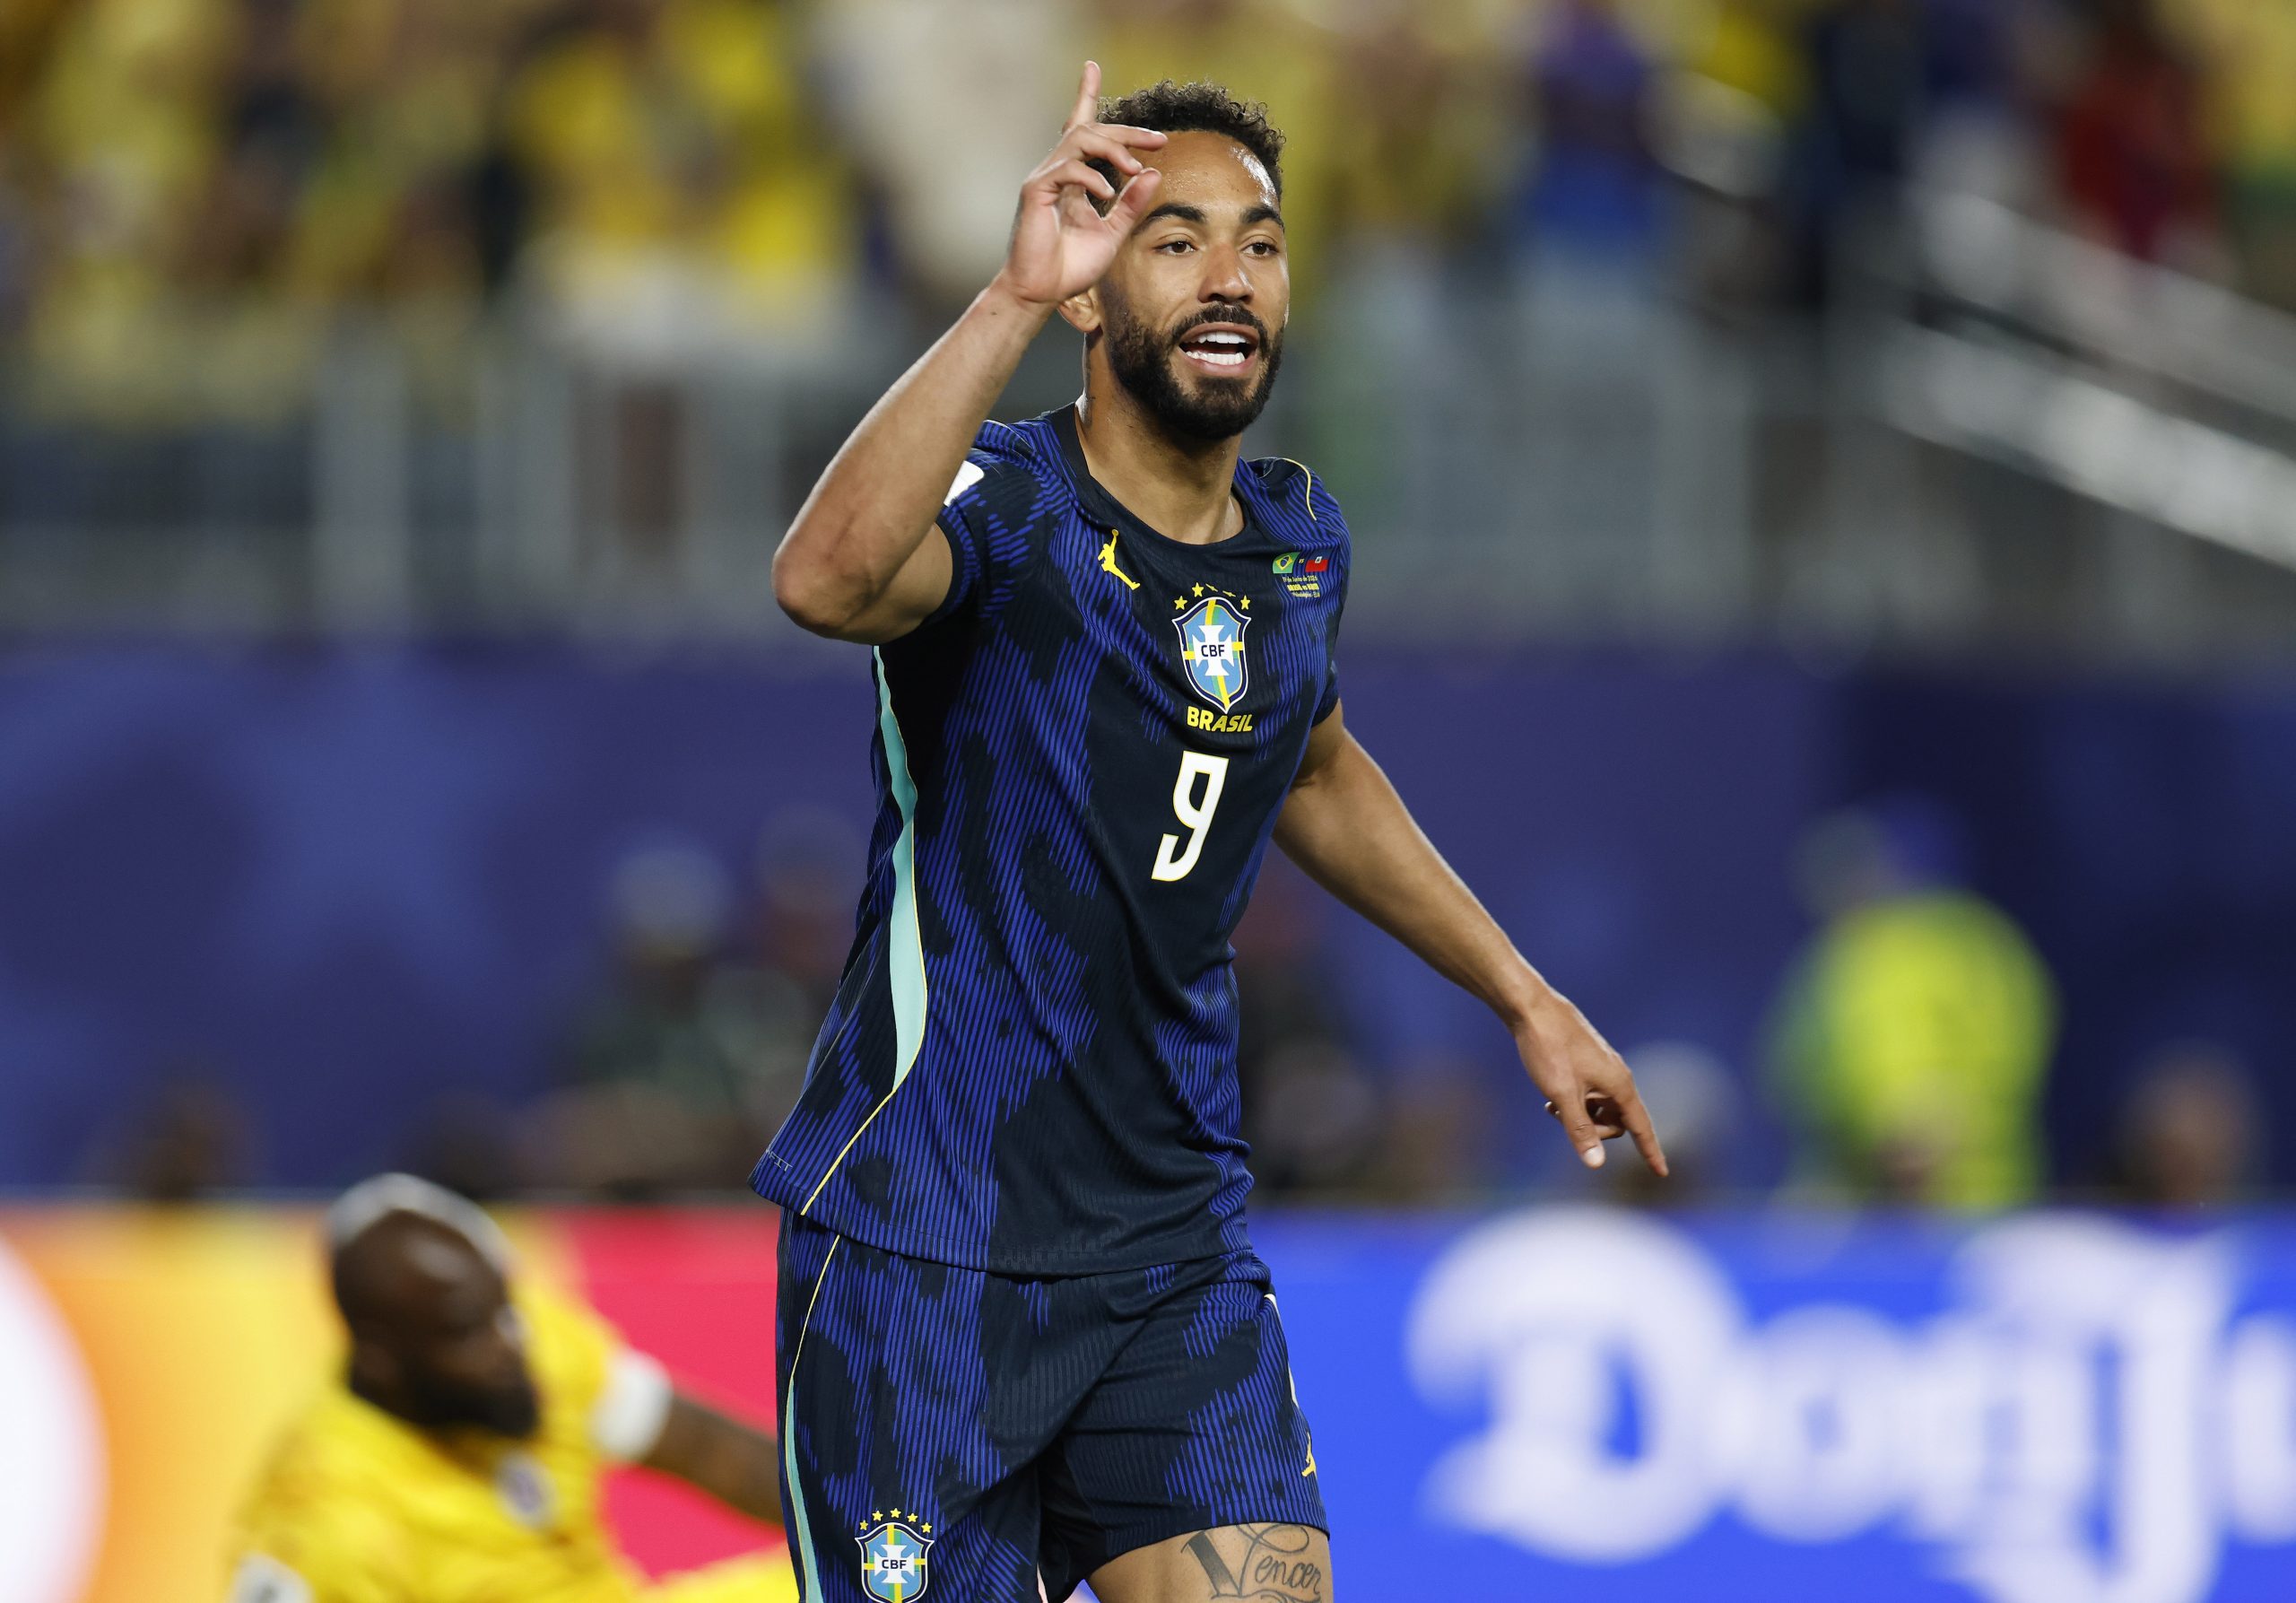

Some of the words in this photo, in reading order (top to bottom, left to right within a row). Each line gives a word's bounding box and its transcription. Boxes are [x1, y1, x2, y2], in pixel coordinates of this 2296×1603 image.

[1201, 644, 1225, 658] CBF
[1187, 705, 1253, 732] BRASIL
[1151, 750, 1230, 882] 9
[881, 1559, 908, 1570] CBF
[1180, 1522, 1322, 1597] Vencer
